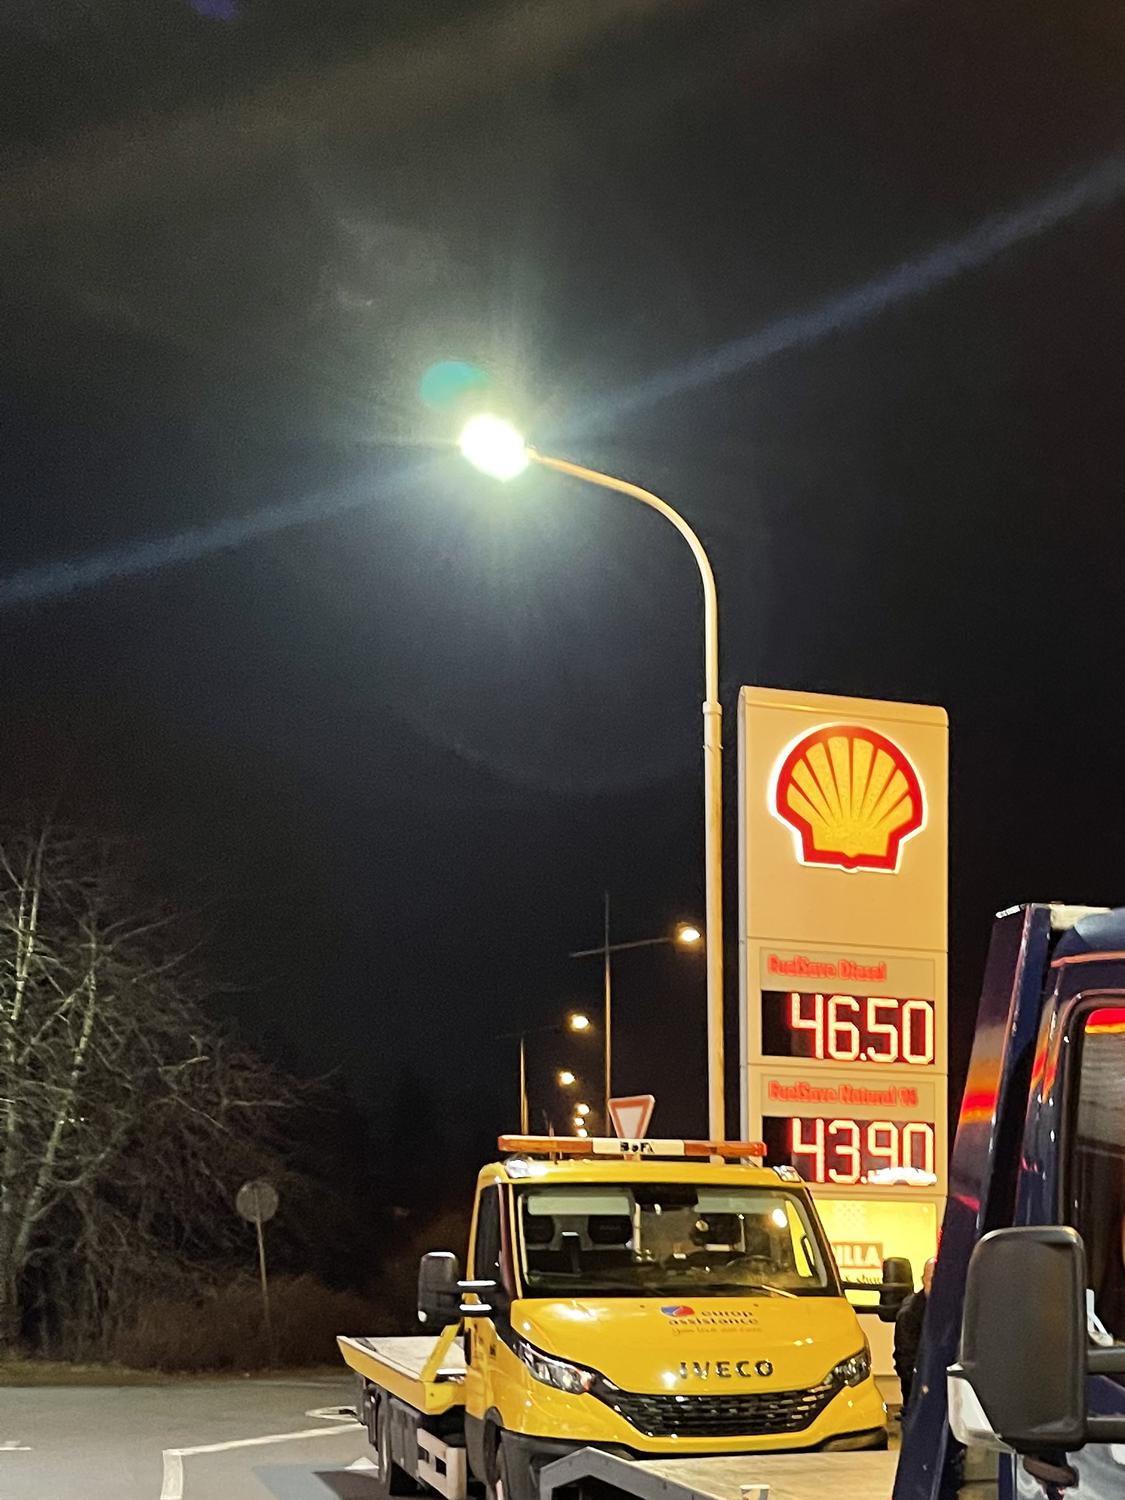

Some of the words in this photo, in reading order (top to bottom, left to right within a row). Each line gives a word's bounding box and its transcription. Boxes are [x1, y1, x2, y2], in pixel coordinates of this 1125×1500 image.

[838, 959, 887, 981] Diesel
[790, 992, 934, 1065] 46.50
[839, 1083, 897, 1106] Natural
[790, 1117, 935, 1186] 43.90
[833, 1245, 880, 1267] ILLA
[669, 1317, 759, 1326] assistance
[680, 1359, 774, 1380] IVECO
